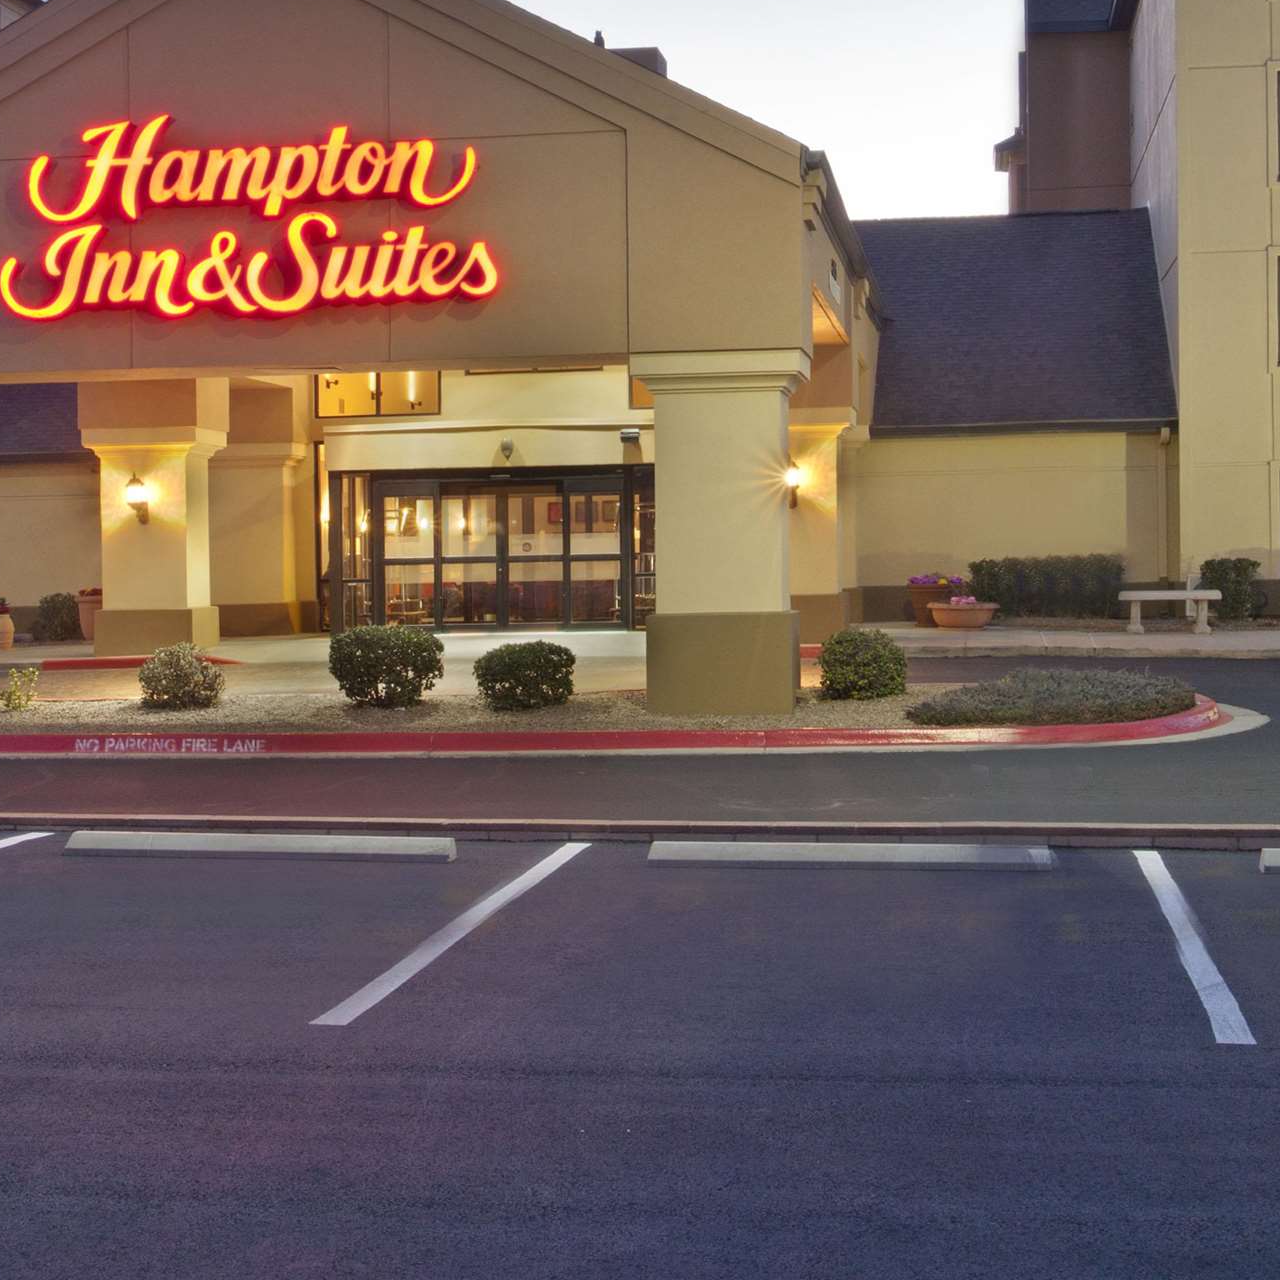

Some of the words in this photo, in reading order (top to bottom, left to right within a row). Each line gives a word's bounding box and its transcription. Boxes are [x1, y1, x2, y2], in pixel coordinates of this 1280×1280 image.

[29, 114, 476, 221] Hampton
[75, 738, 100, 753] NO
[104, 737, 176, 753] PARKING
[181, 738, 218, 752] FIRE
[223, 738, 267, 753] LANE
